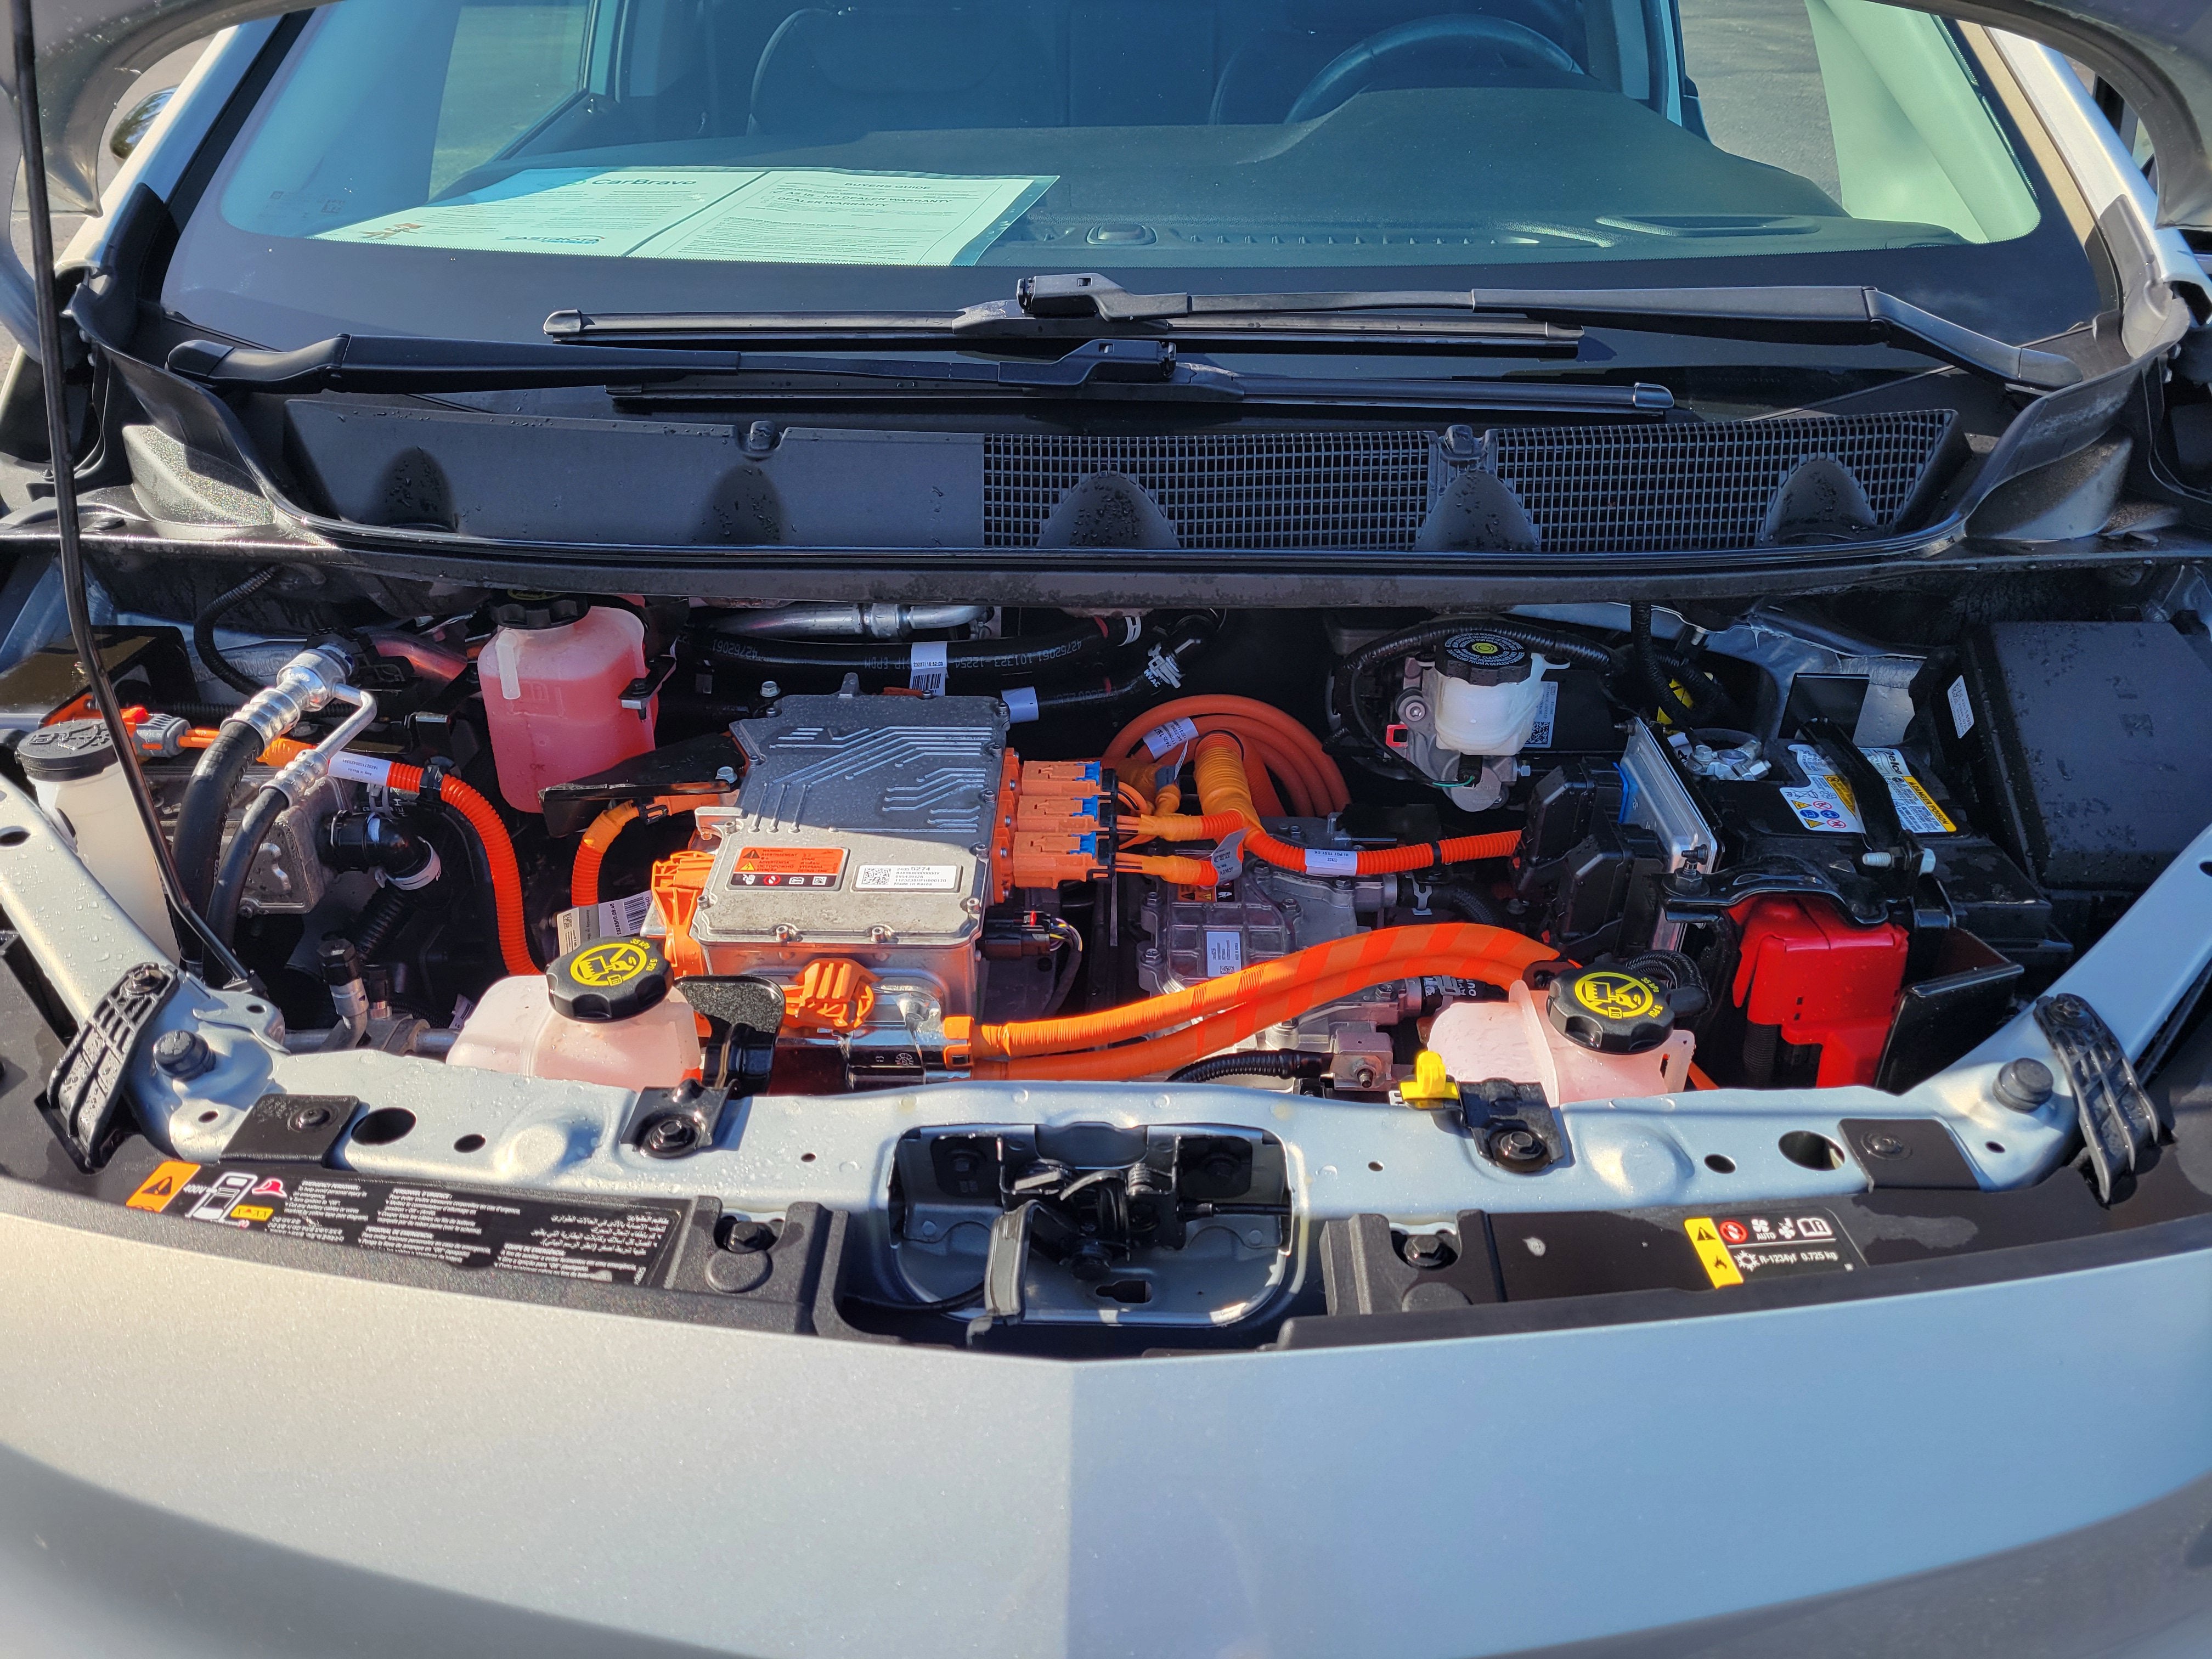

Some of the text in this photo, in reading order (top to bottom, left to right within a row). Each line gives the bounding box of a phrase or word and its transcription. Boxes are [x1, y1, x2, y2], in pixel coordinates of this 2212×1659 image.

[712, 639, 758, 660] 42762061
[1037, 639, 1083, 662] 42762061
[183, 1184, 207, 1195] 400V
[1756, 1232, 1777, 1241] AUTO
[1759, 1251, 1838, 1265] R-1234yf 0.725 kg
